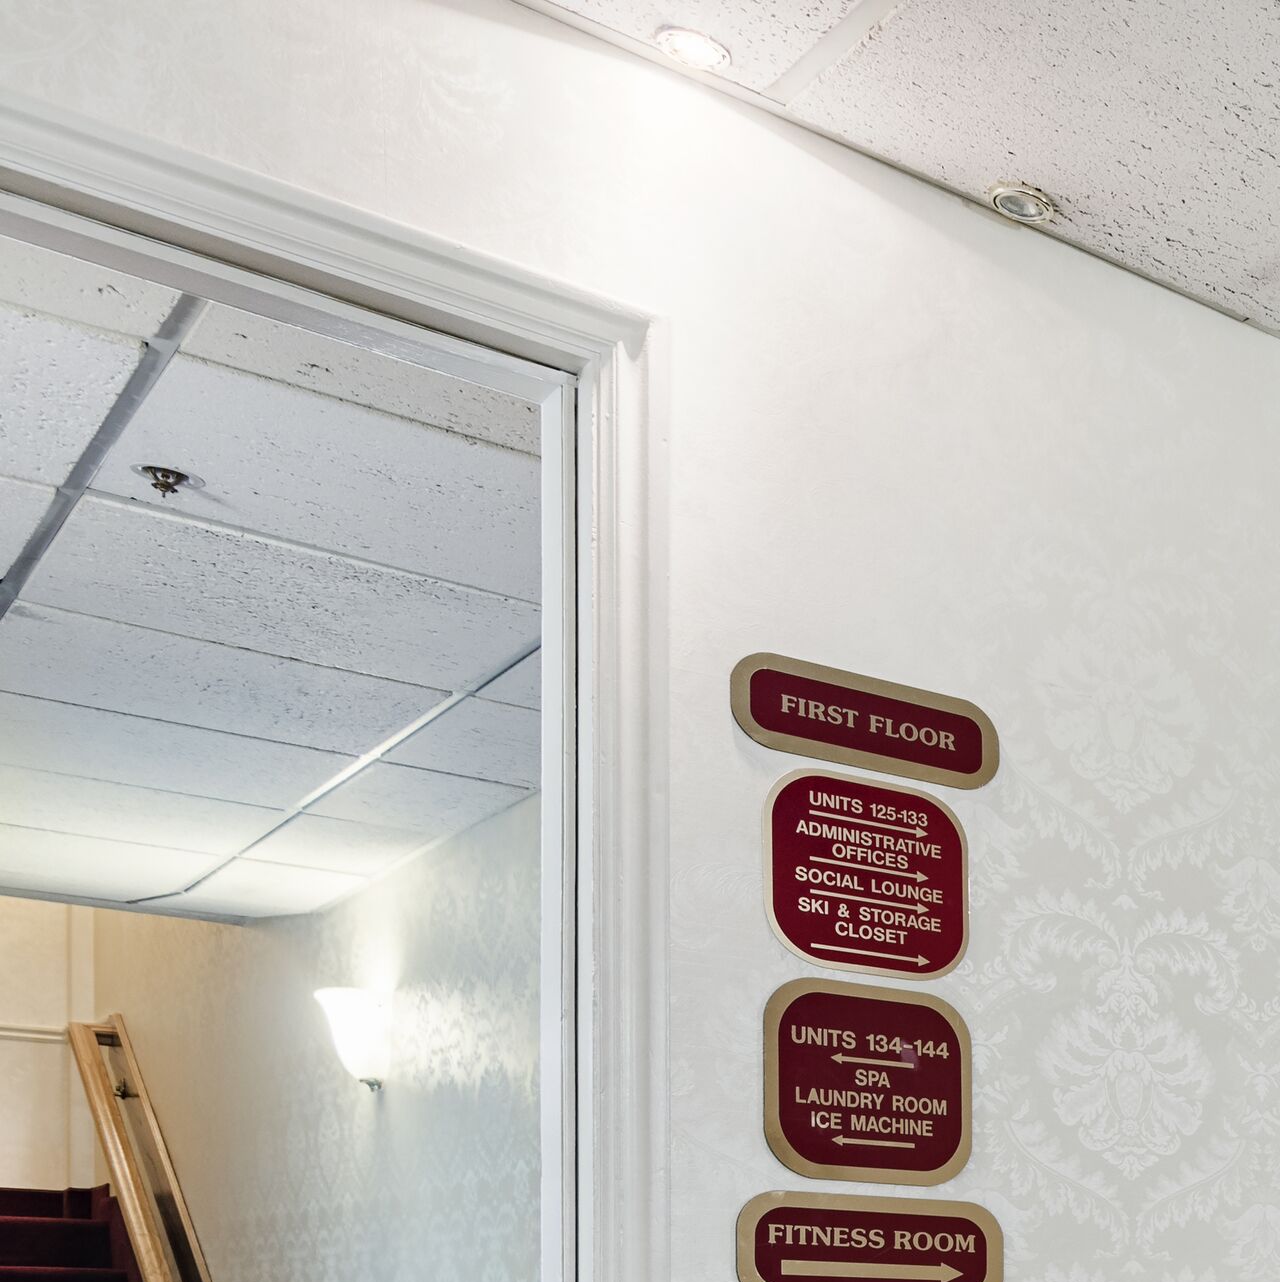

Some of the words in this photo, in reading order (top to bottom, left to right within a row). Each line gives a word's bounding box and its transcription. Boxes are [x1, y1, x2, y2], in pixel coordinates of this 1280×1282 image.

[781, 694, 859, 728] FIRST
[869, 715, 956, 751] FLOOR
[809, 790, 863, 814] UNITS
[870, 803, 928, 827] 125-133
[796, 820, 942, 859] ADMINISTRATIVE
[832, 844, 909, 869] OFFICES
[795, 866, 864, 891] SOCIAL
[871, 879, 943, 904] LOUNGE
[798, 897, 829, 915] SKI
[838, 904, 850, 918] &
[859, 907, 941, 932] STORAGE
[835, 922, 907, 945] CLOSET
[791, 1025, 856, 1049] UNITS
[866, 1034, 949, 1059] 134-144
[855, 1069, 890, 1088] SPA
[795, 1087, 884, 1110] LAUNDRY
[892, 1095, 947, 1115] ROOM
[811, 1111, 842, 1129] ICE
[851, 1114, 933, 1136] MACHINE
[768, 1224, 885, 1249] FITNESS
[893, 1230, 976, 1253] ROOM
